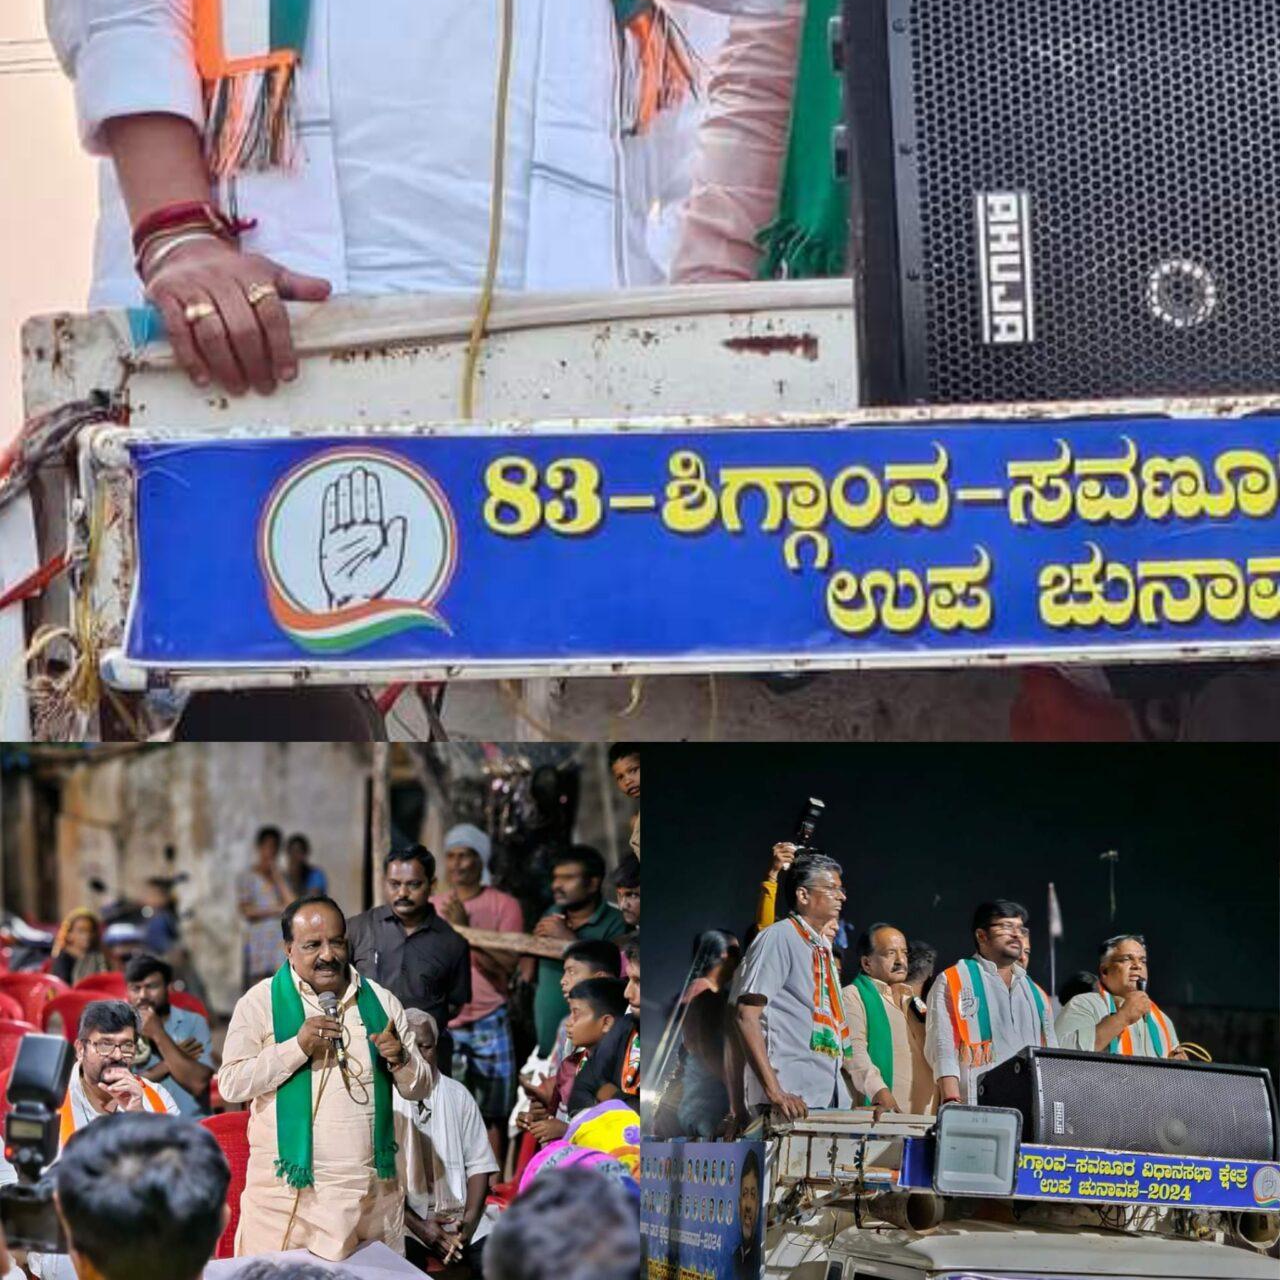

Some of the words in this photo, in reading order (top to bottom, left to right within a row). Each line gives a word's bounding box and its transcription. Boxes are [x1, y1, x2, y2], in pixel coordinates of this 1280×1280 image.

[983, 193, 1029, 343] AHUJA
[826, 544, 992, 632] ಉಪ
[1040, 1176, 1071, 1195] ಉಪ
[1141, 1162, 1213, 1182] ವಿಧಾನಸಭಾ
[1219, 1164, 1249, 1190] ಕ್ಷೇತ್ರ
